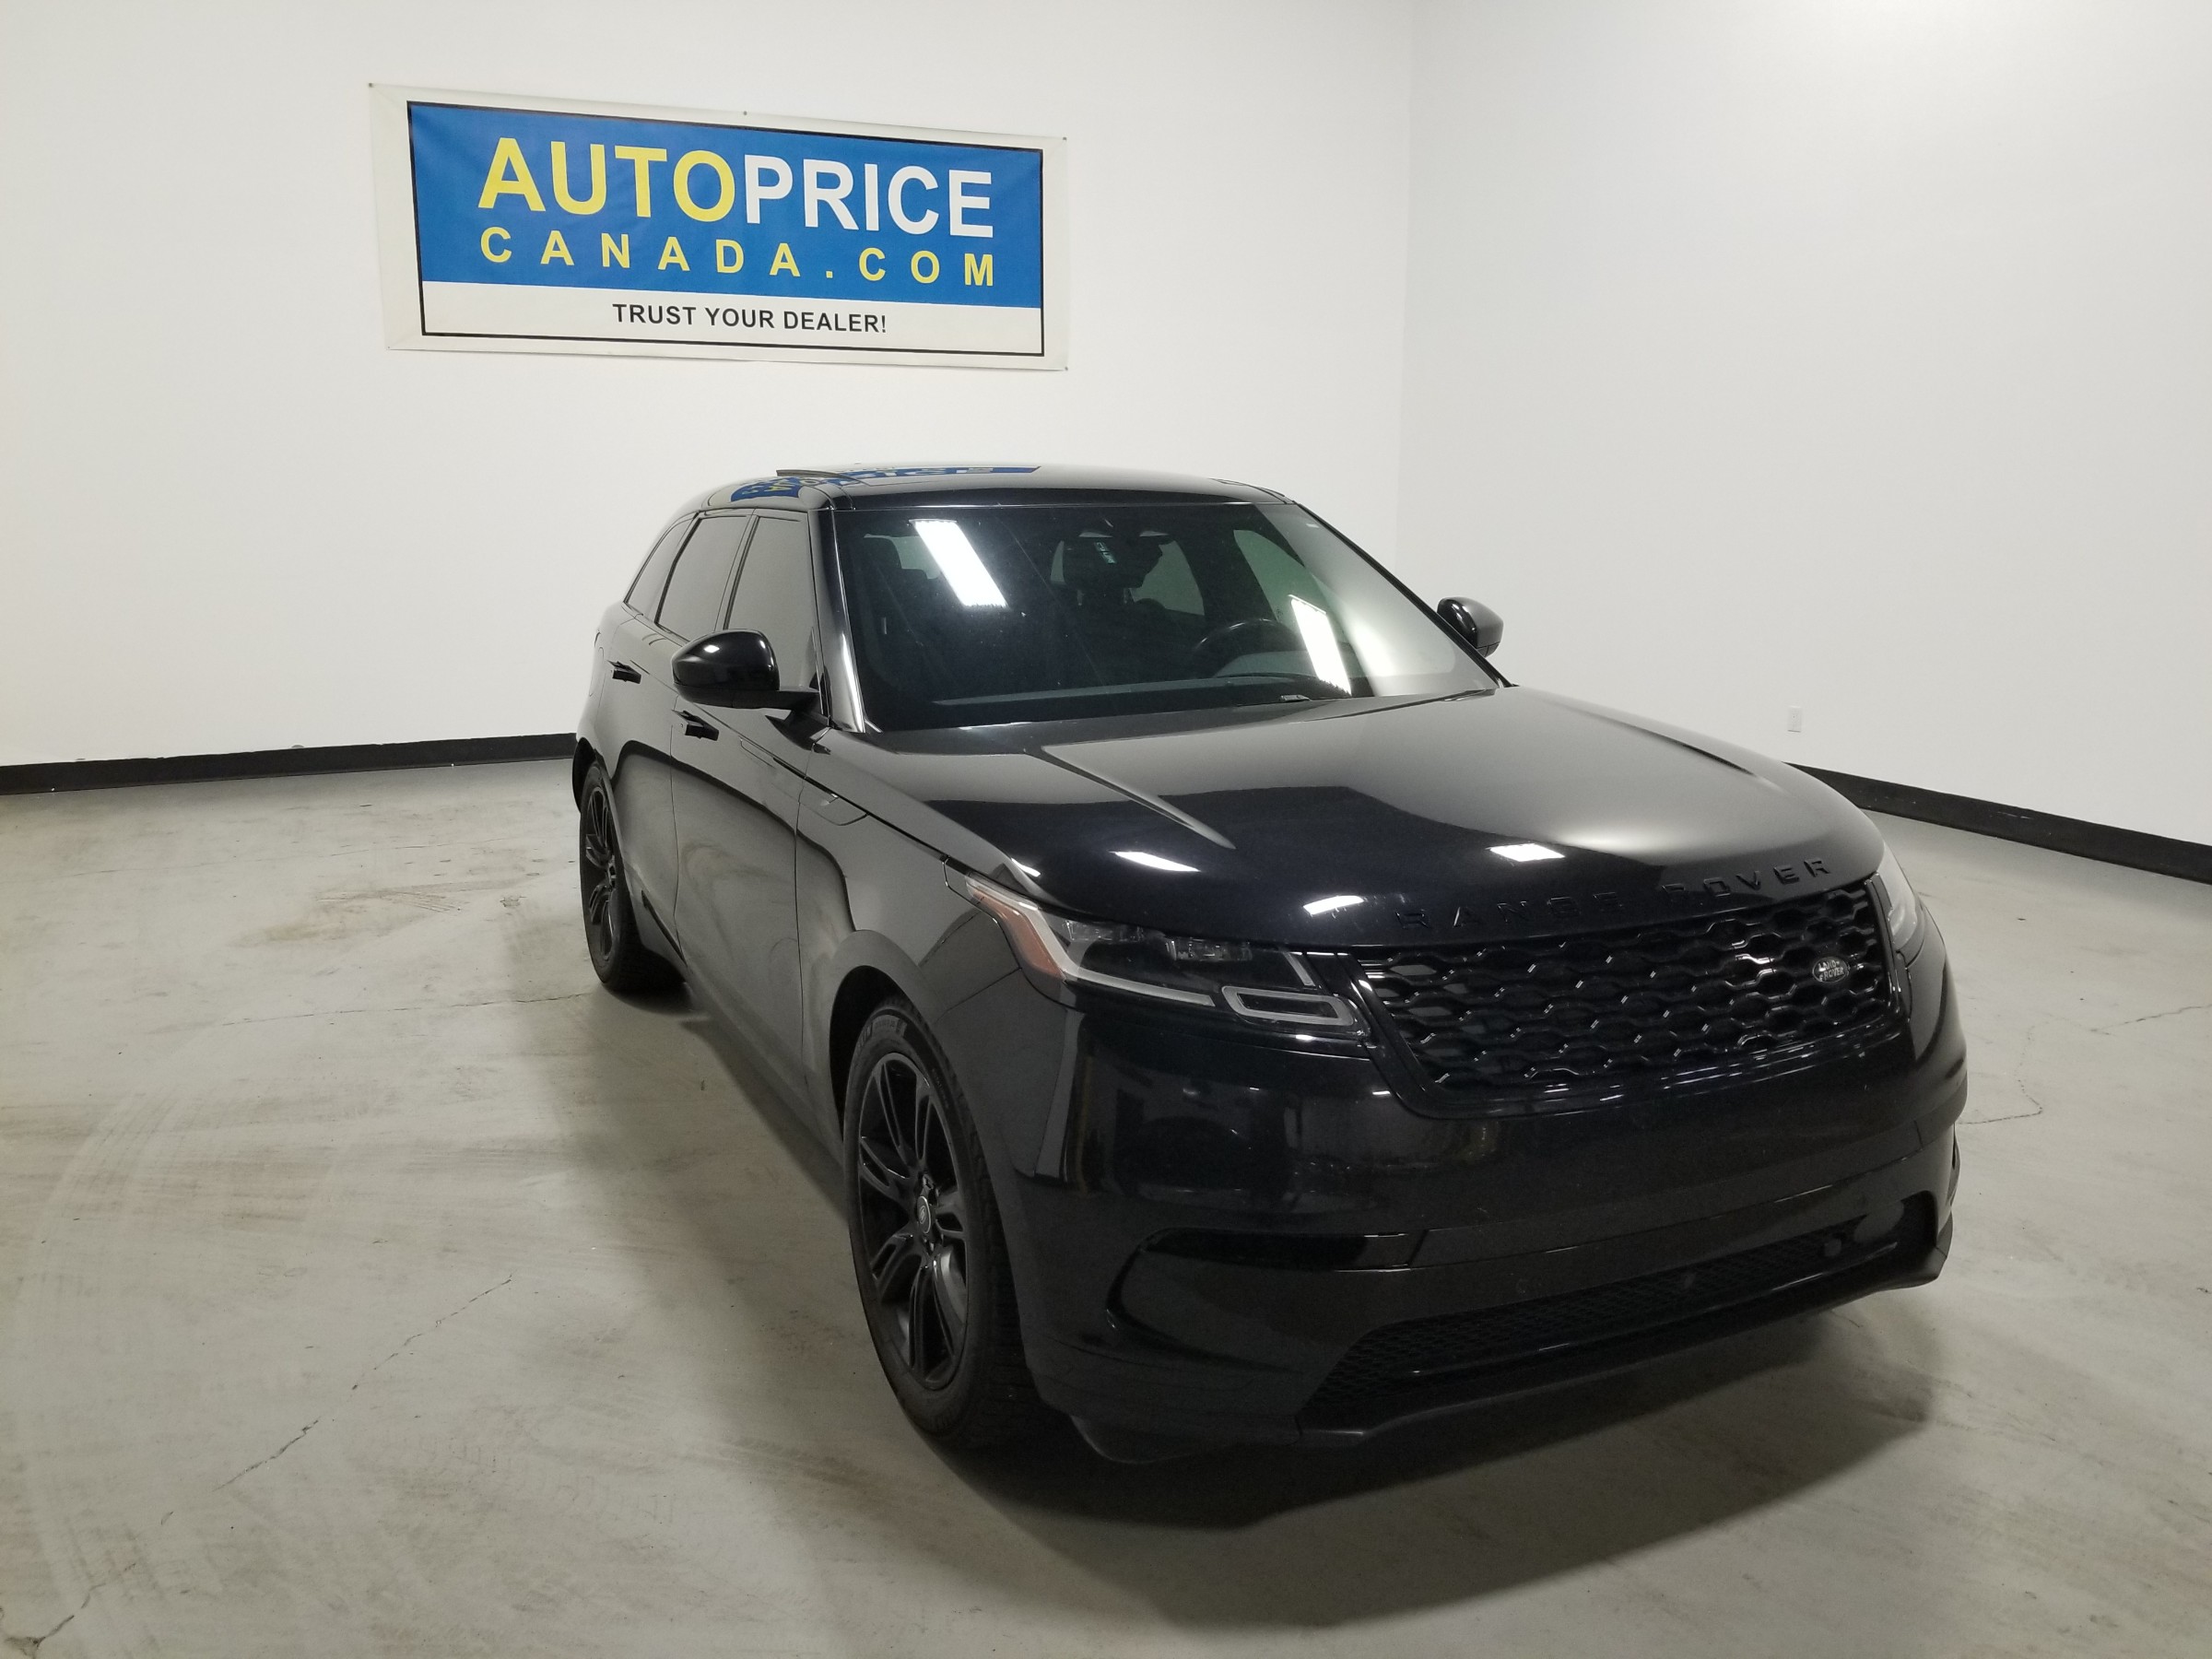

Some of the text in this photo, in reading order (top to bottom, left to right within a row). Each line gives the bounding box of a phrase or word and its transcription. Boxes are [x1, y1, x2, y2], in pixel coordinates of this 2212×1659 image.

[477, 136, 994, 238] AUTOPRICE
[612, 303, 887, 334] TRUST YOUR DEALER!
[1395, 856, 1831, 929] RANGE ROVER
